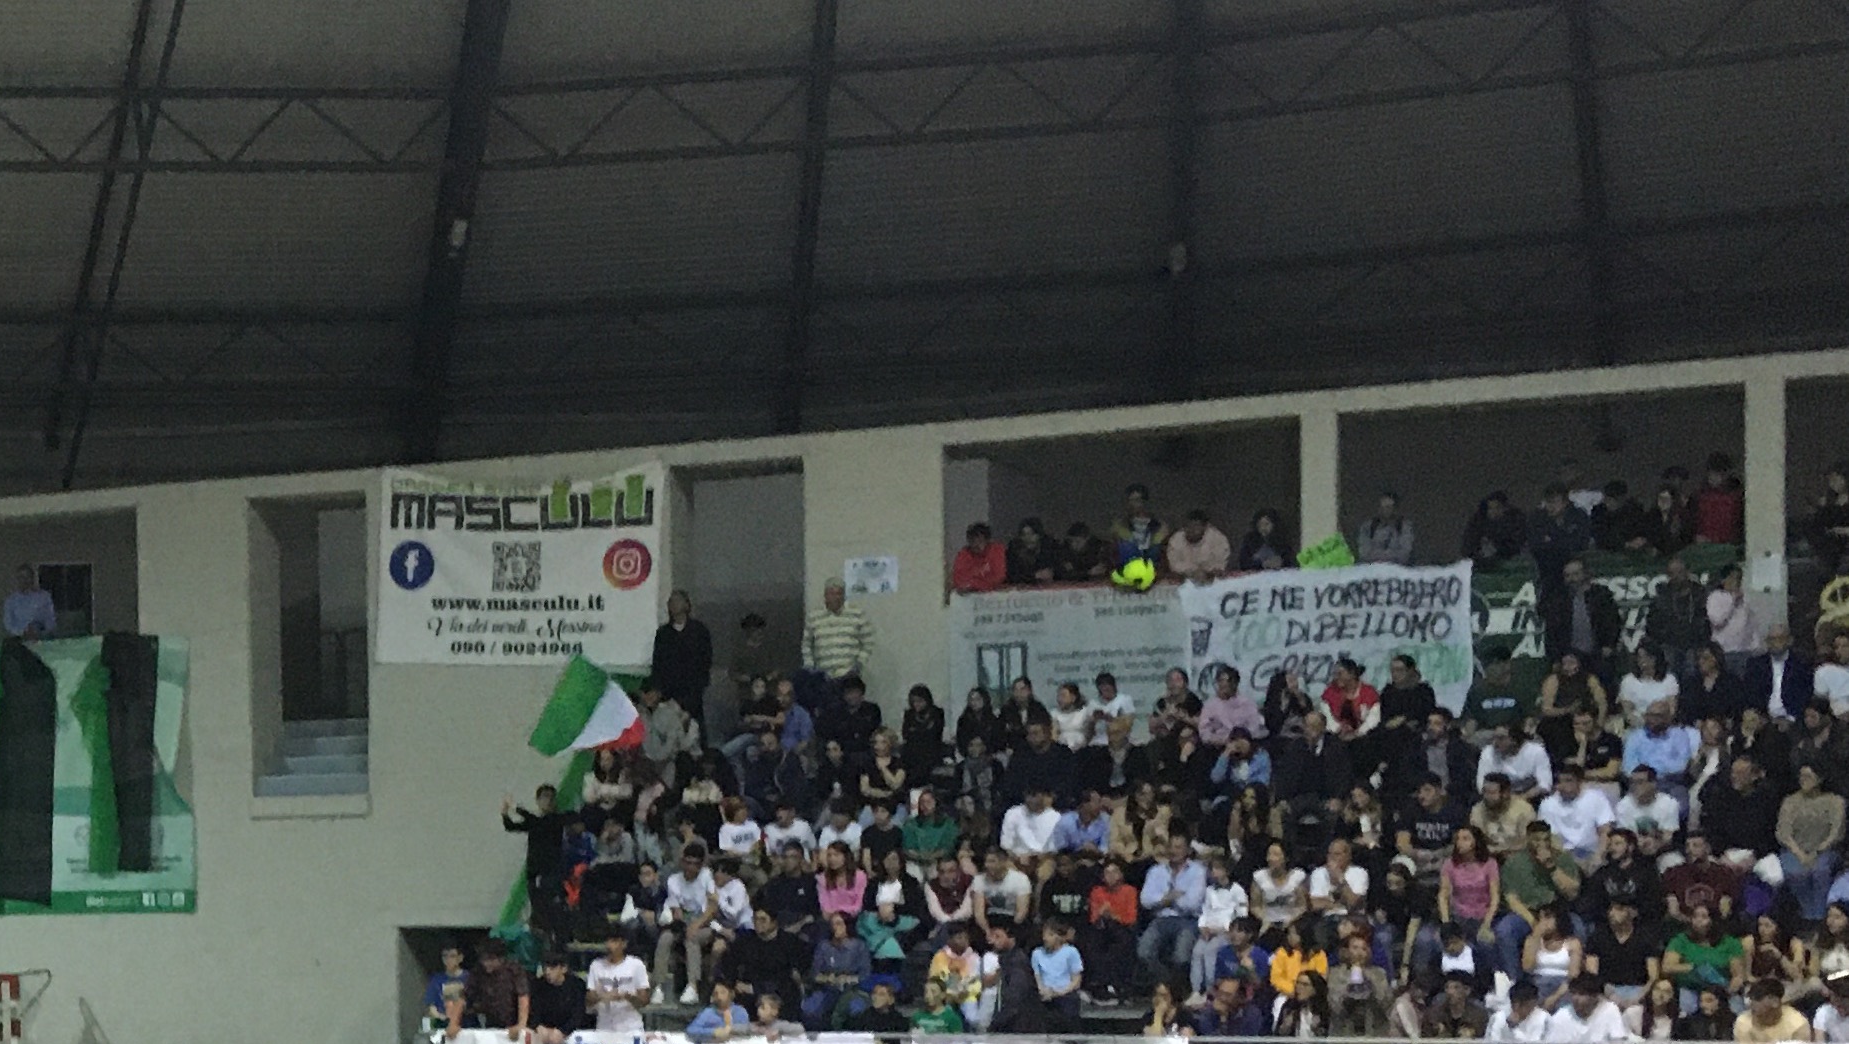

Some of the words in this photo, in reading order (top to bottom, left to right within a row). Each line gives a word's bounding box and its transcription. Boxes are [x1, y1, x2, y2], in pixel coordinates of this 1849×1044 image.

[390, 487, 654, 532] MASCULU
[431, 594, 605, 612] www.masculu.it
[1220, 589, 1260, 619] CE
[1267, 584, 1305, 613] NE
